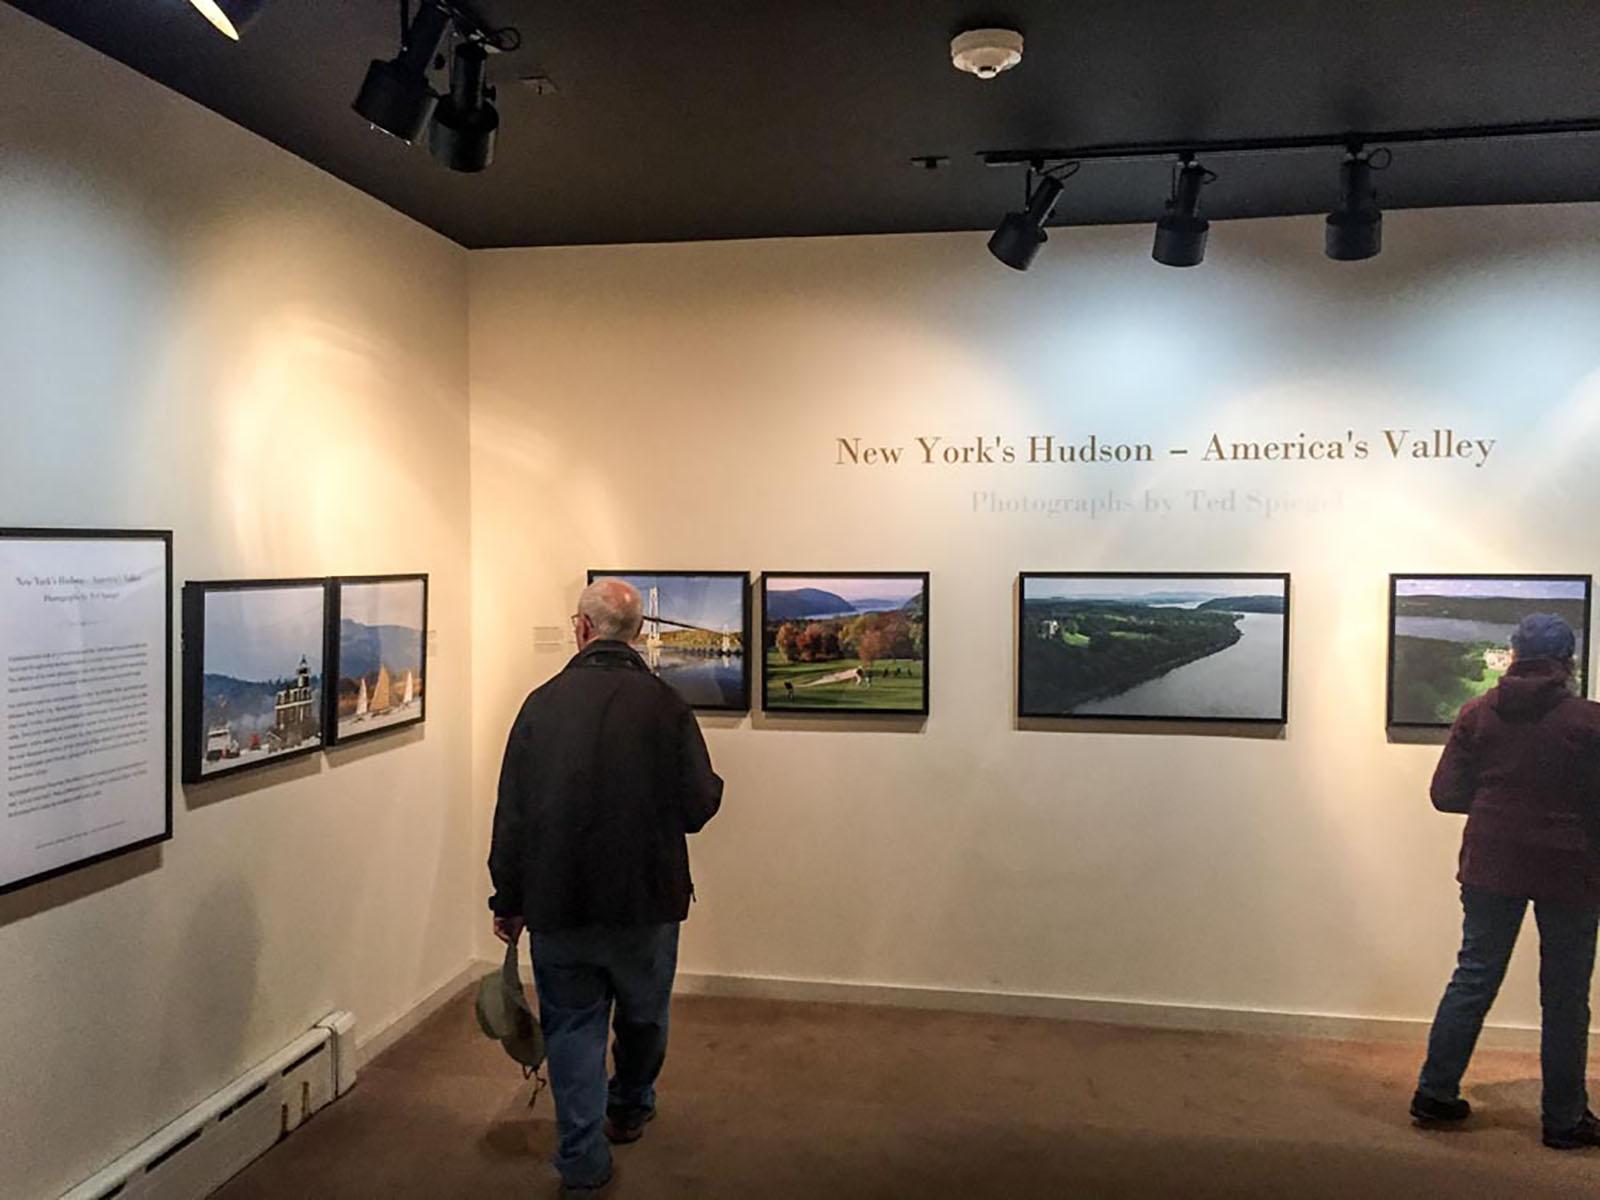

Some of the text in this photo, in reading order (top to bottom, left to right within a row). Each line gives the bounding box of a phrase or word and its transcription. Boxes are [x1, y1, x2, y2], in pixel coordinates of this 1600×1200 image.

[836, 437, 903, 464] New
[914, 436, 1015, 463] York's
[1026, 434, 1154, 462] Hudson
[1201, 430, 1369, 461] America's
[1381, 429, 1496, 468] Valley
[971, 490, 1133, 518] Photographs
[1144, 490, 1173, 516] by
[1185, 489, 1236, 512] Ted
